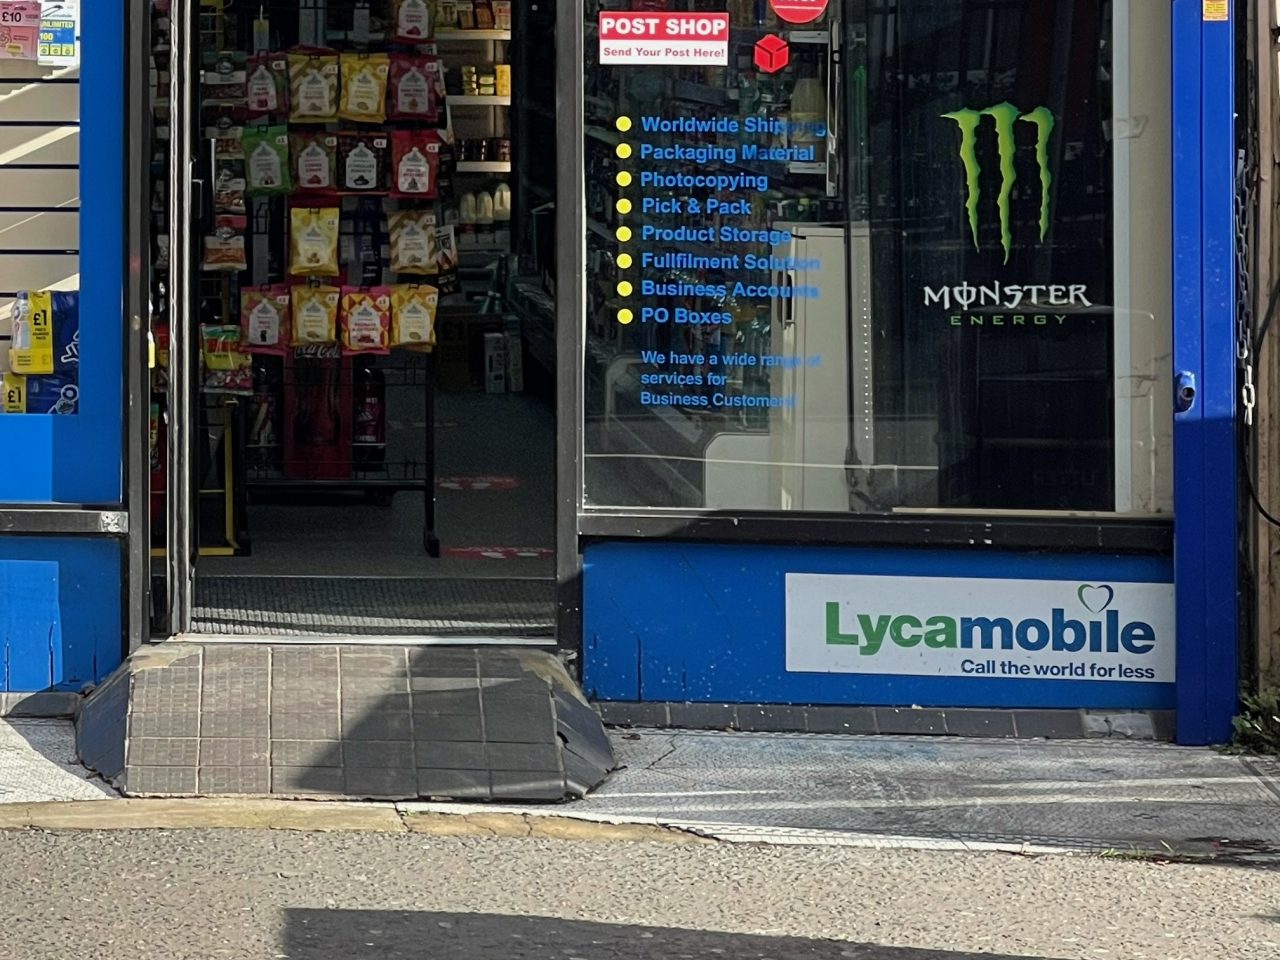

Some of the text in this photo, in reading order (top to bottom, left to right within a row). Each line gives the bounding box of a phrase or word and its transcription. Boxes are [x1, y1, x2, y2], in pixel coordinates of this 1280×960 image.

[2, 12, 22, 22] £10
[601, 18, 726, 35] POST SHOP
[603, 47, 725, 58] Send Your Post Here!
[641, 116, 739, 133] Worldwide
[640, 144, 815, 164] Packaging Material
[640, 171, 768, 192] Photocopying
[642, 198, 752, 215] Pick & Pack
[642, 225, 792, 246] Product Storage
[642, 252, 739, 269] Fullfilment
[641, 280, 727, 297] Business
[923, 280, 1093, 310] MONSTER
[33, 309, 47, 326] £1
[641, 307, 733, 324] PO Boxes
[950, 315, 1067, 326] ENERGY
[641, 351, 665, 364] We
[670, 351, 705, 364] have
[709, 355, 718, 365] a
[722, 352, 756, 365] wide
[640, 372, 728, 385] services for
[7, 387, 22, 403] £1
[640, 392, 708, 406] Business
[825, 602, 1155, 656] Lycamobile
[961, 659, 1155, 679] Call the world for less
